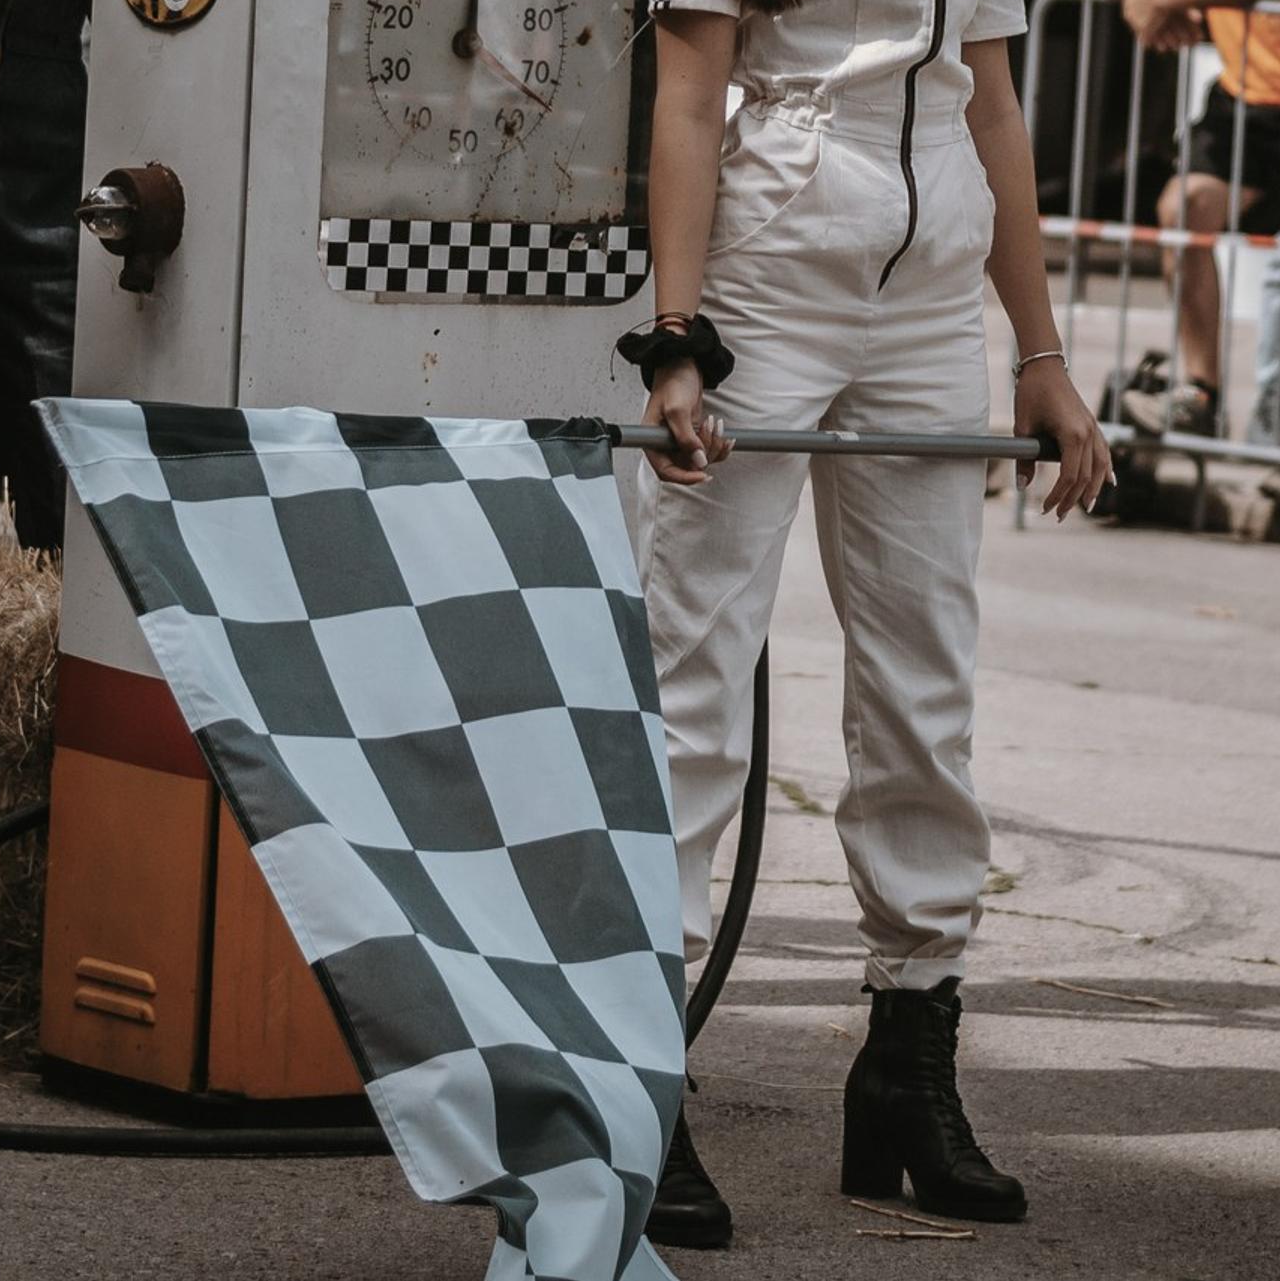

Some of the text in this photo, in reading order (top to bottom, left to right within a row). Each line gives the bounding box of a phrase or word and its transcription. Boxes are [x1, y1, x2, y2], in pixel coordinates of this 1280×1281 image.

[383, 5, 413, 29] 20
[523, 7, 553, 32] 80
[380, 57, 411, 82] 30
[522, 60, 550, 83] 70
[404, 106, 432, 131] 40
[495, 108, 525, 133] 60
[449, 129, 479, 153] 50
